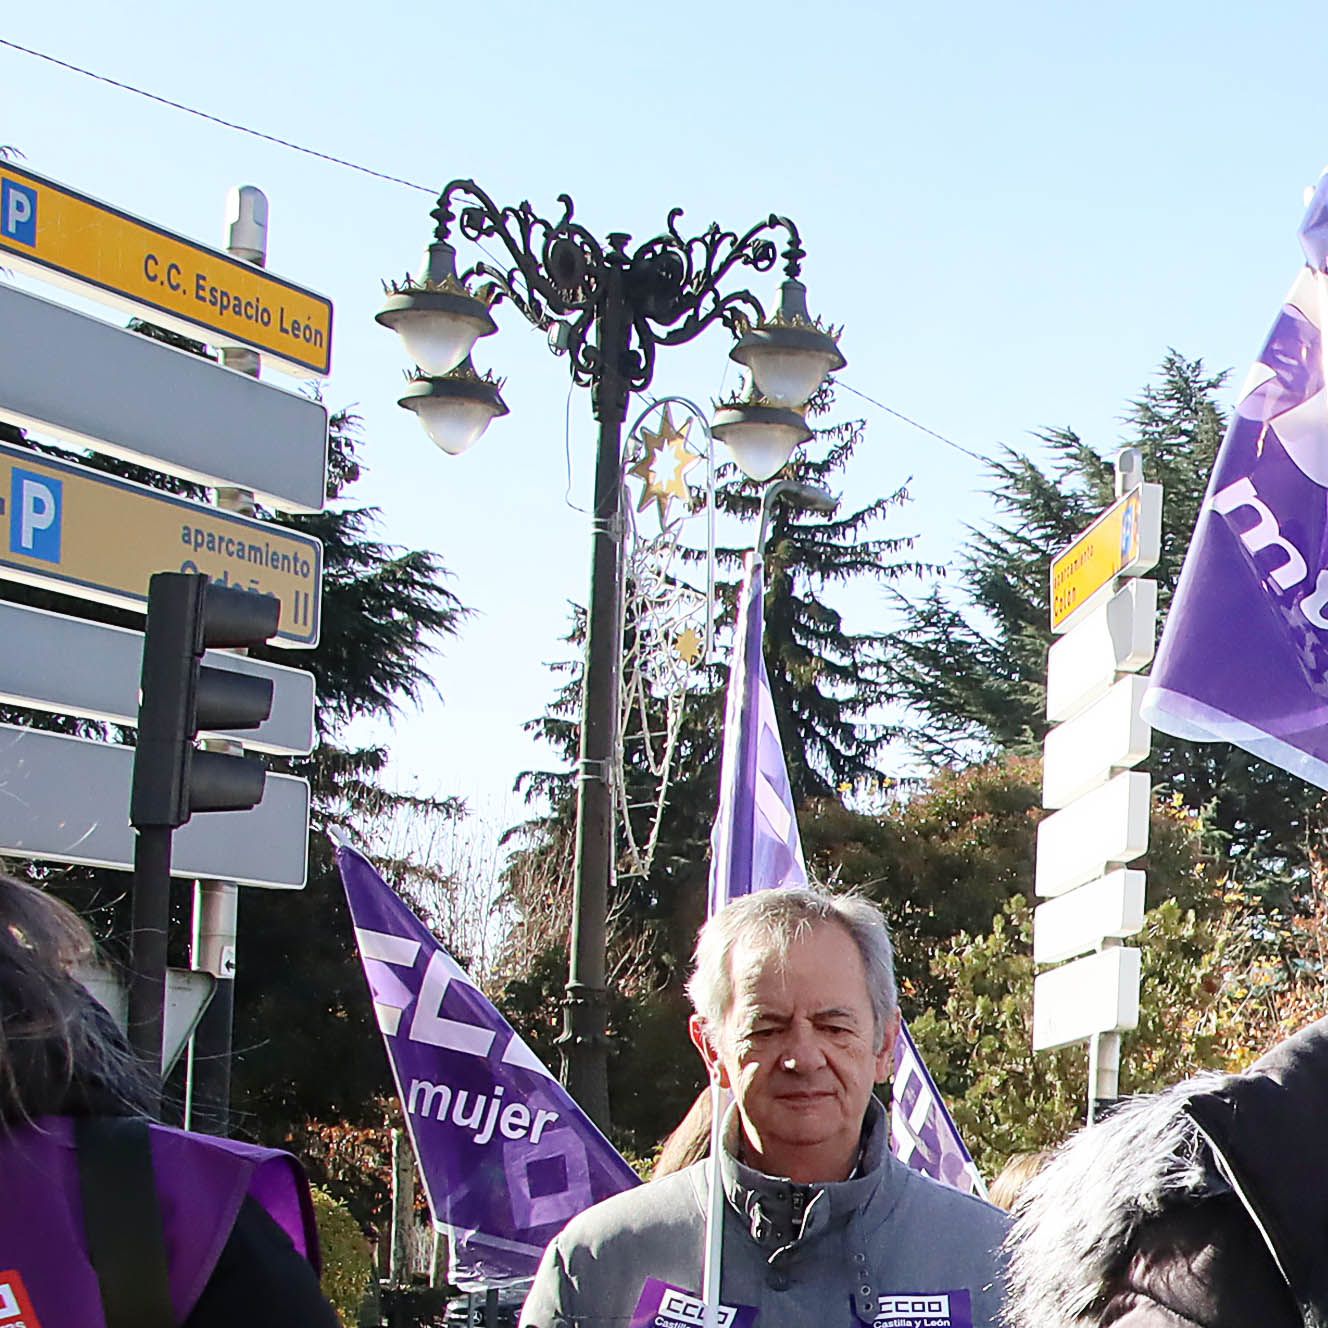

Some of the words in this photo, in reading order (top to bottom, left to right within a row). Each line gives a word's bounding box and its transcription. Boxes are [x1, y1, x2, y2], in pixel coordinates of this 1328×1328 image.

[143, 254, 187, 295] C.C.
[195, 274, 271, 327] Espacio
[279, 307, 324, 349] León
[181, 524, 311, 578] aparcamiento
[408, 1077, 559, 1145] mujer
[877, 1298, 945, 1317] CCOO
[915, 1320, 923, 1328] y
[924, 1318, 951, 1328] León
